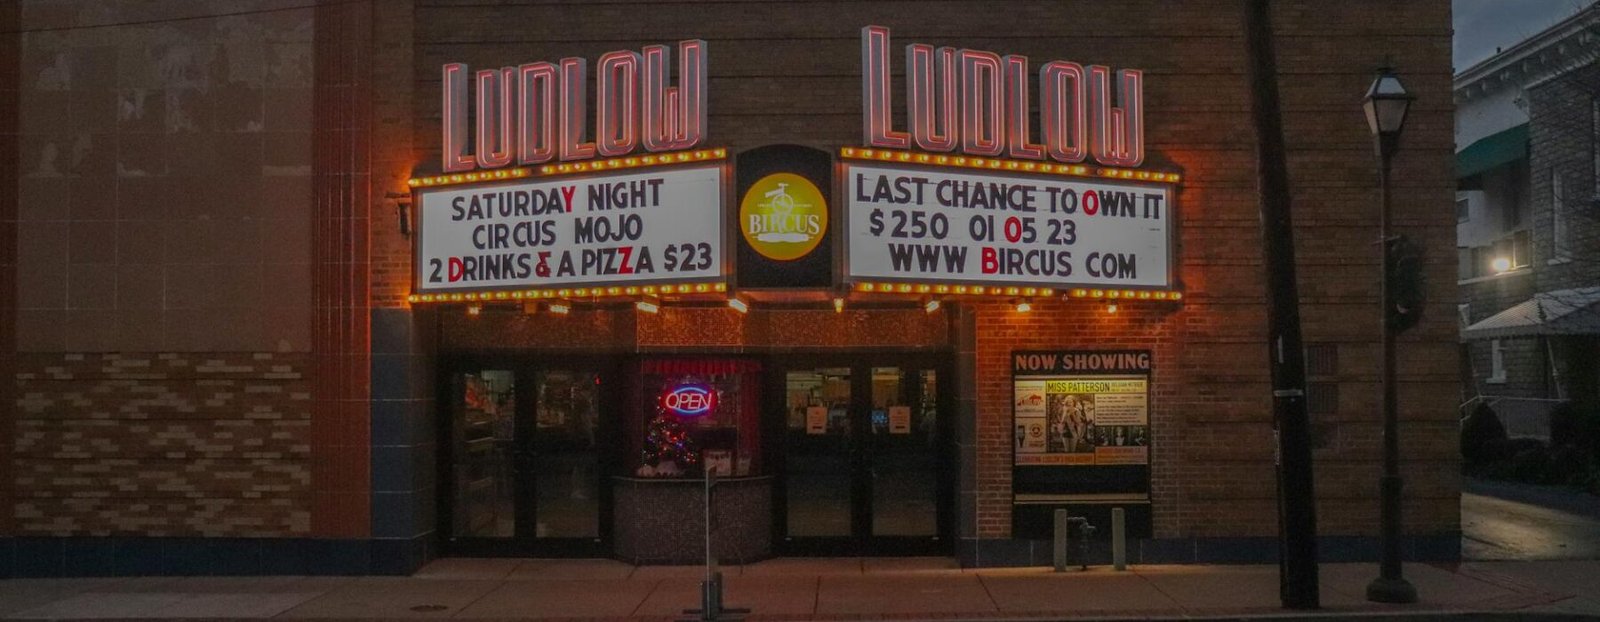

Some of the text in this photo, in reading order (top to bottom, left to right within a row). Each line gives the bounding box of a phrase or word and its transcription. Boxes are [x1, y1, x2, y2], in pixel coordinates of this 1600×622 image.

[442, 39, 708, 173] LUDLOW
[861, 25, 1144, 167] LUDLOW
[451, 178, 664, 221] SATURDAY NIGHT
[856, 173, 1163, 219] LAST CHANCE TO OWN IT
[472, 213, 643, 250] CIRCUS MOJO
[749, 214, 820, 235] BIRCUS
[1004, 216, 1037, 244] 05
[1047, 218, 1077, 246] 23
[429, 242, 712, 283] 2 DRINKS & A PIZZA $23
[888, 243, 1137, 279] WWW BIRCUS COM
[1015, 353, 1150, 371] NOW SHOWING
[665, 392, 712, 410] OPEN
[1047, 382, 1067, 393] MISS
[1068, 381, 1111, 393] PATTERSON
